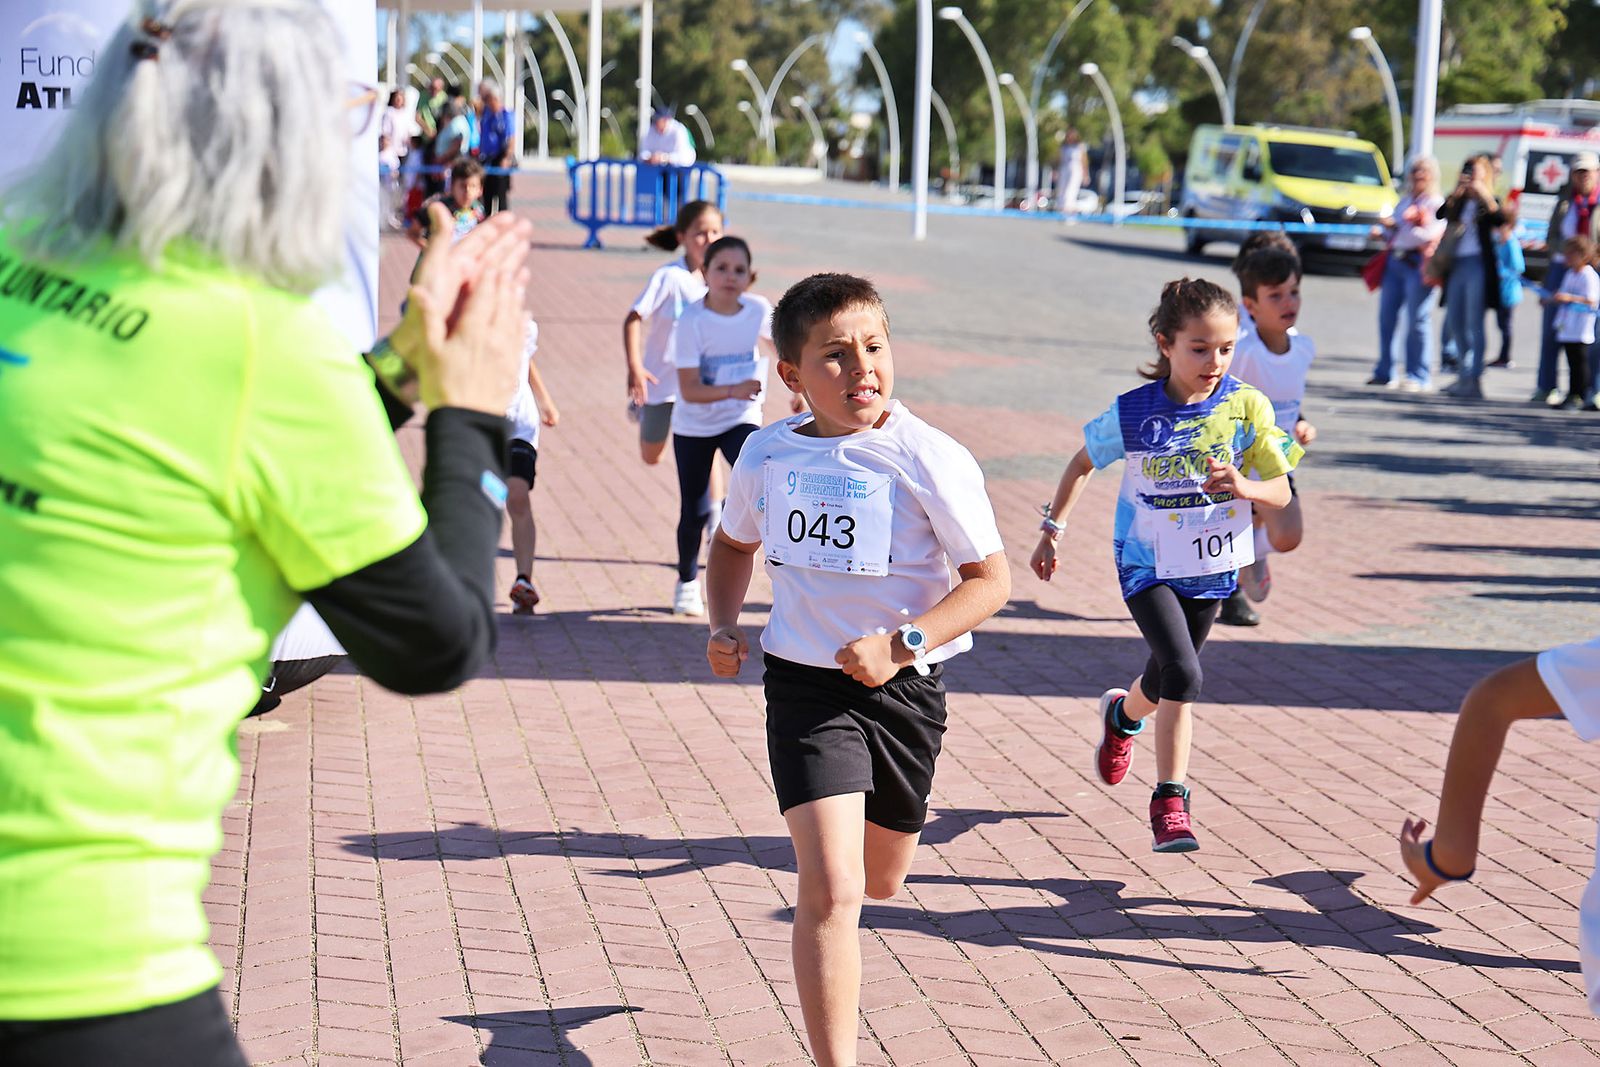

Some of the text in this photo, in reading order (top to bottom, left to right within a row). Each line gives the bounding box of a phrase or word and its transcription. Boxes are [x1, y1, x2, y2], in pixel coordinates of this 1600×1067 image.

[800, 472, 843, 486] CARRERA
[800, 483, 843, 497] INFANTIL
[847, 482, 867, 492] kilos
[854, 490, 867, 499] km
[787, 509, 856, 550] 043
[1192, 531, 1234, 560] 101
